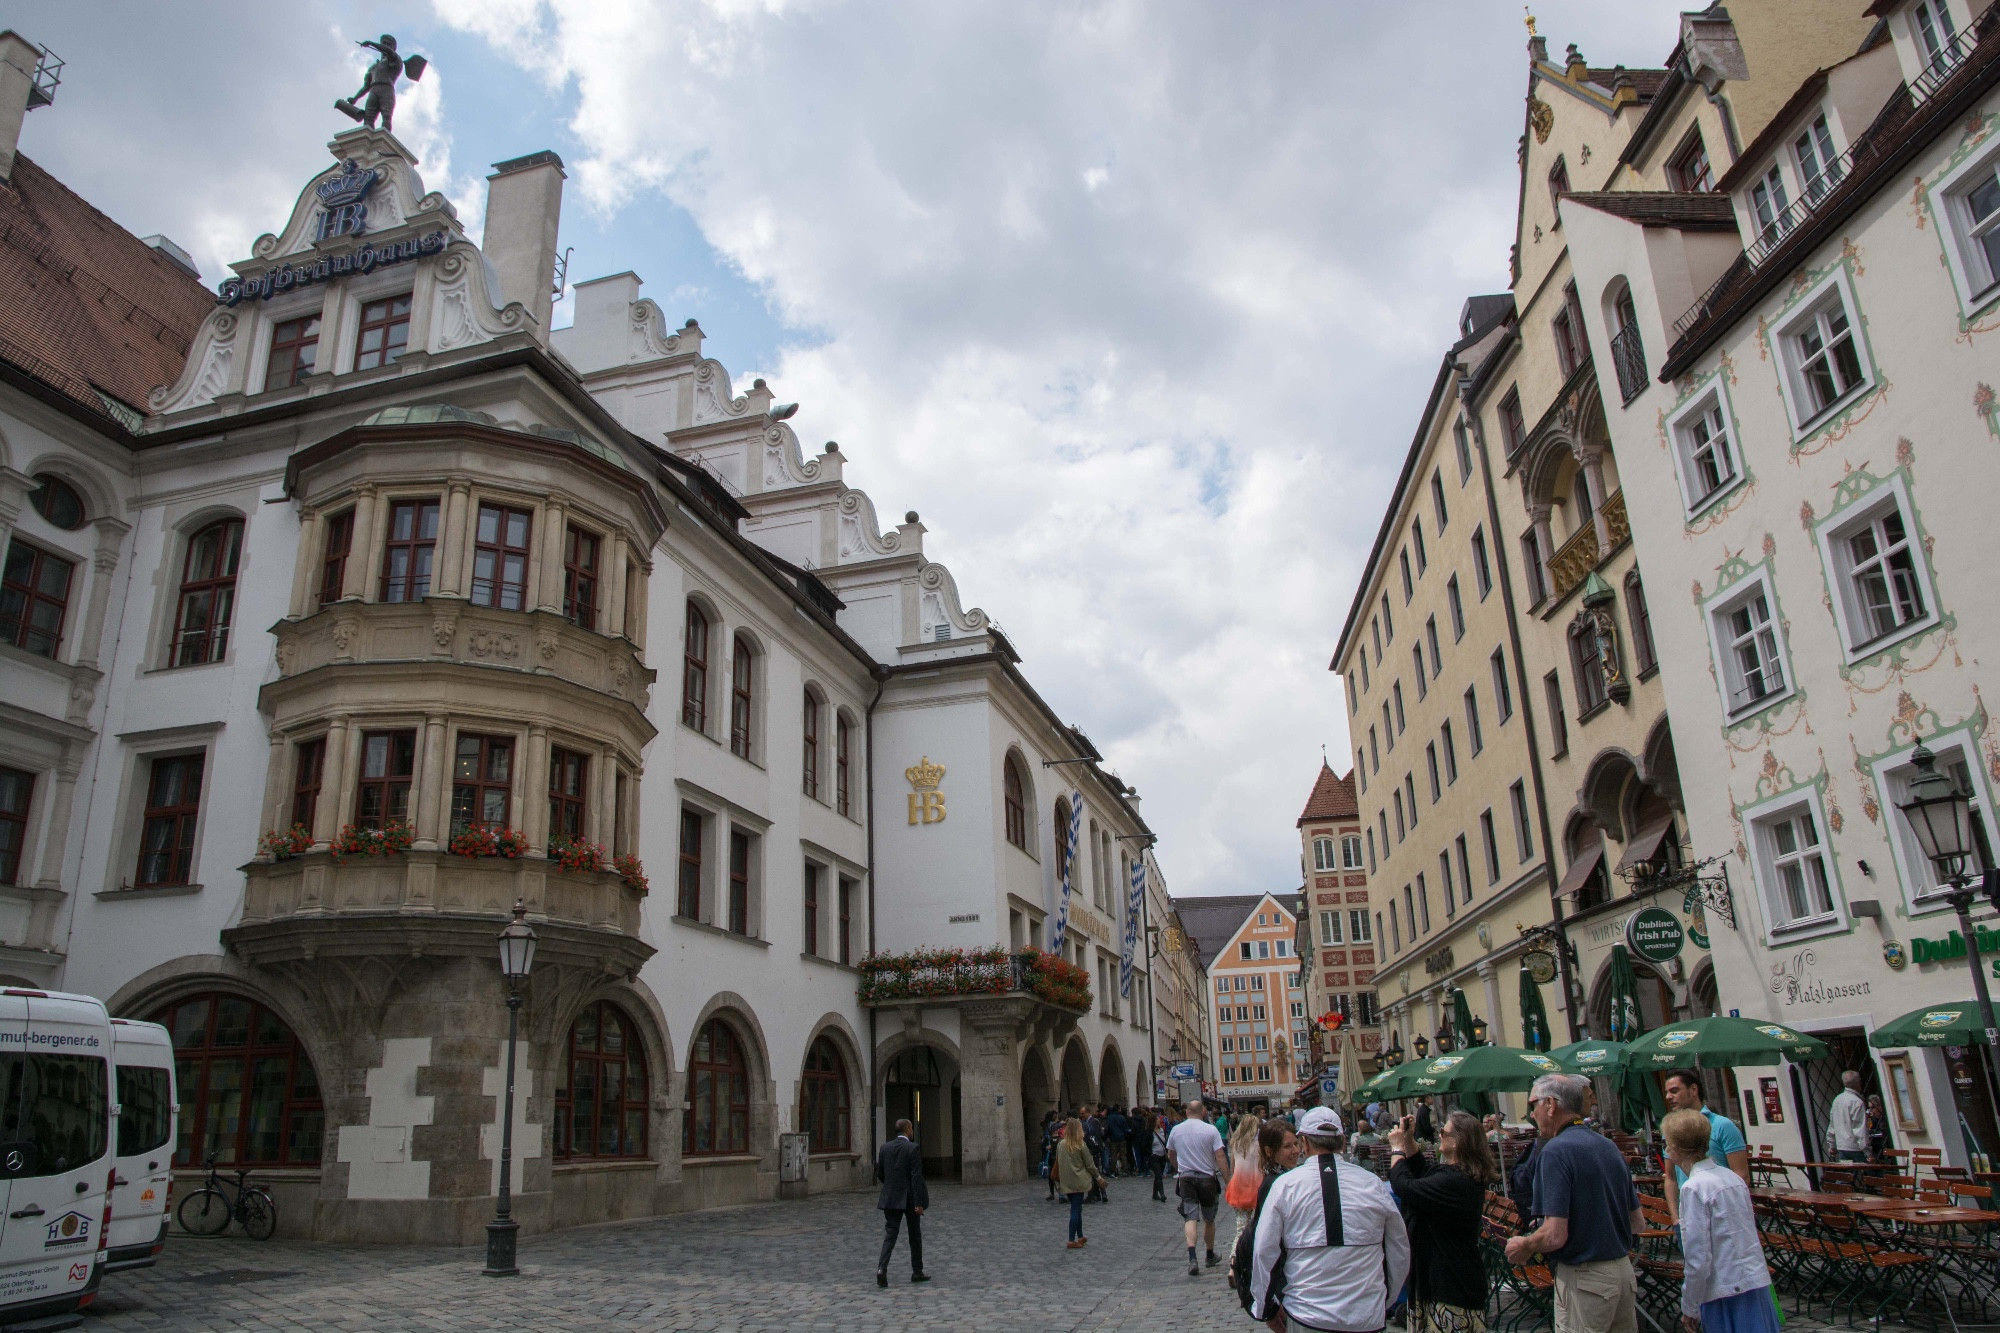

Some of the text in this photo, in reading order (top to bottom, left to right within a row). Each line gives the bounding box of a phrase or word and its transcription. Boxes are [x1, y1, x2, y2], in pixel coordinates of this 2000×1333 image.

[316, 202, 367, 242] HB
[216, 231, 446, 307] Hofbräuhaus
[907, 790, 947, 825] HB
[1638, 920, 1675, 930] Dubliner
[1636, 930, 1681, 941] Irish Pub
[1644, 942, 1677, 950] SPORTSBAR
[1910, 924, 2000, 964] Dubin
[1771, 962, 1871, 1005] Platzlgassen
[0, 1032, 99, 1047] mut-bergener.de
[1918, 1032, 1946, 1040] Ayinger
[1652, 1054, 1676, 1062] Ayinger
[1416, 1077, 1437, 1086] Ayinger
[1227, 1087, 1269, 1096] böhmler
[48, 1222, 88, 1239] H B
